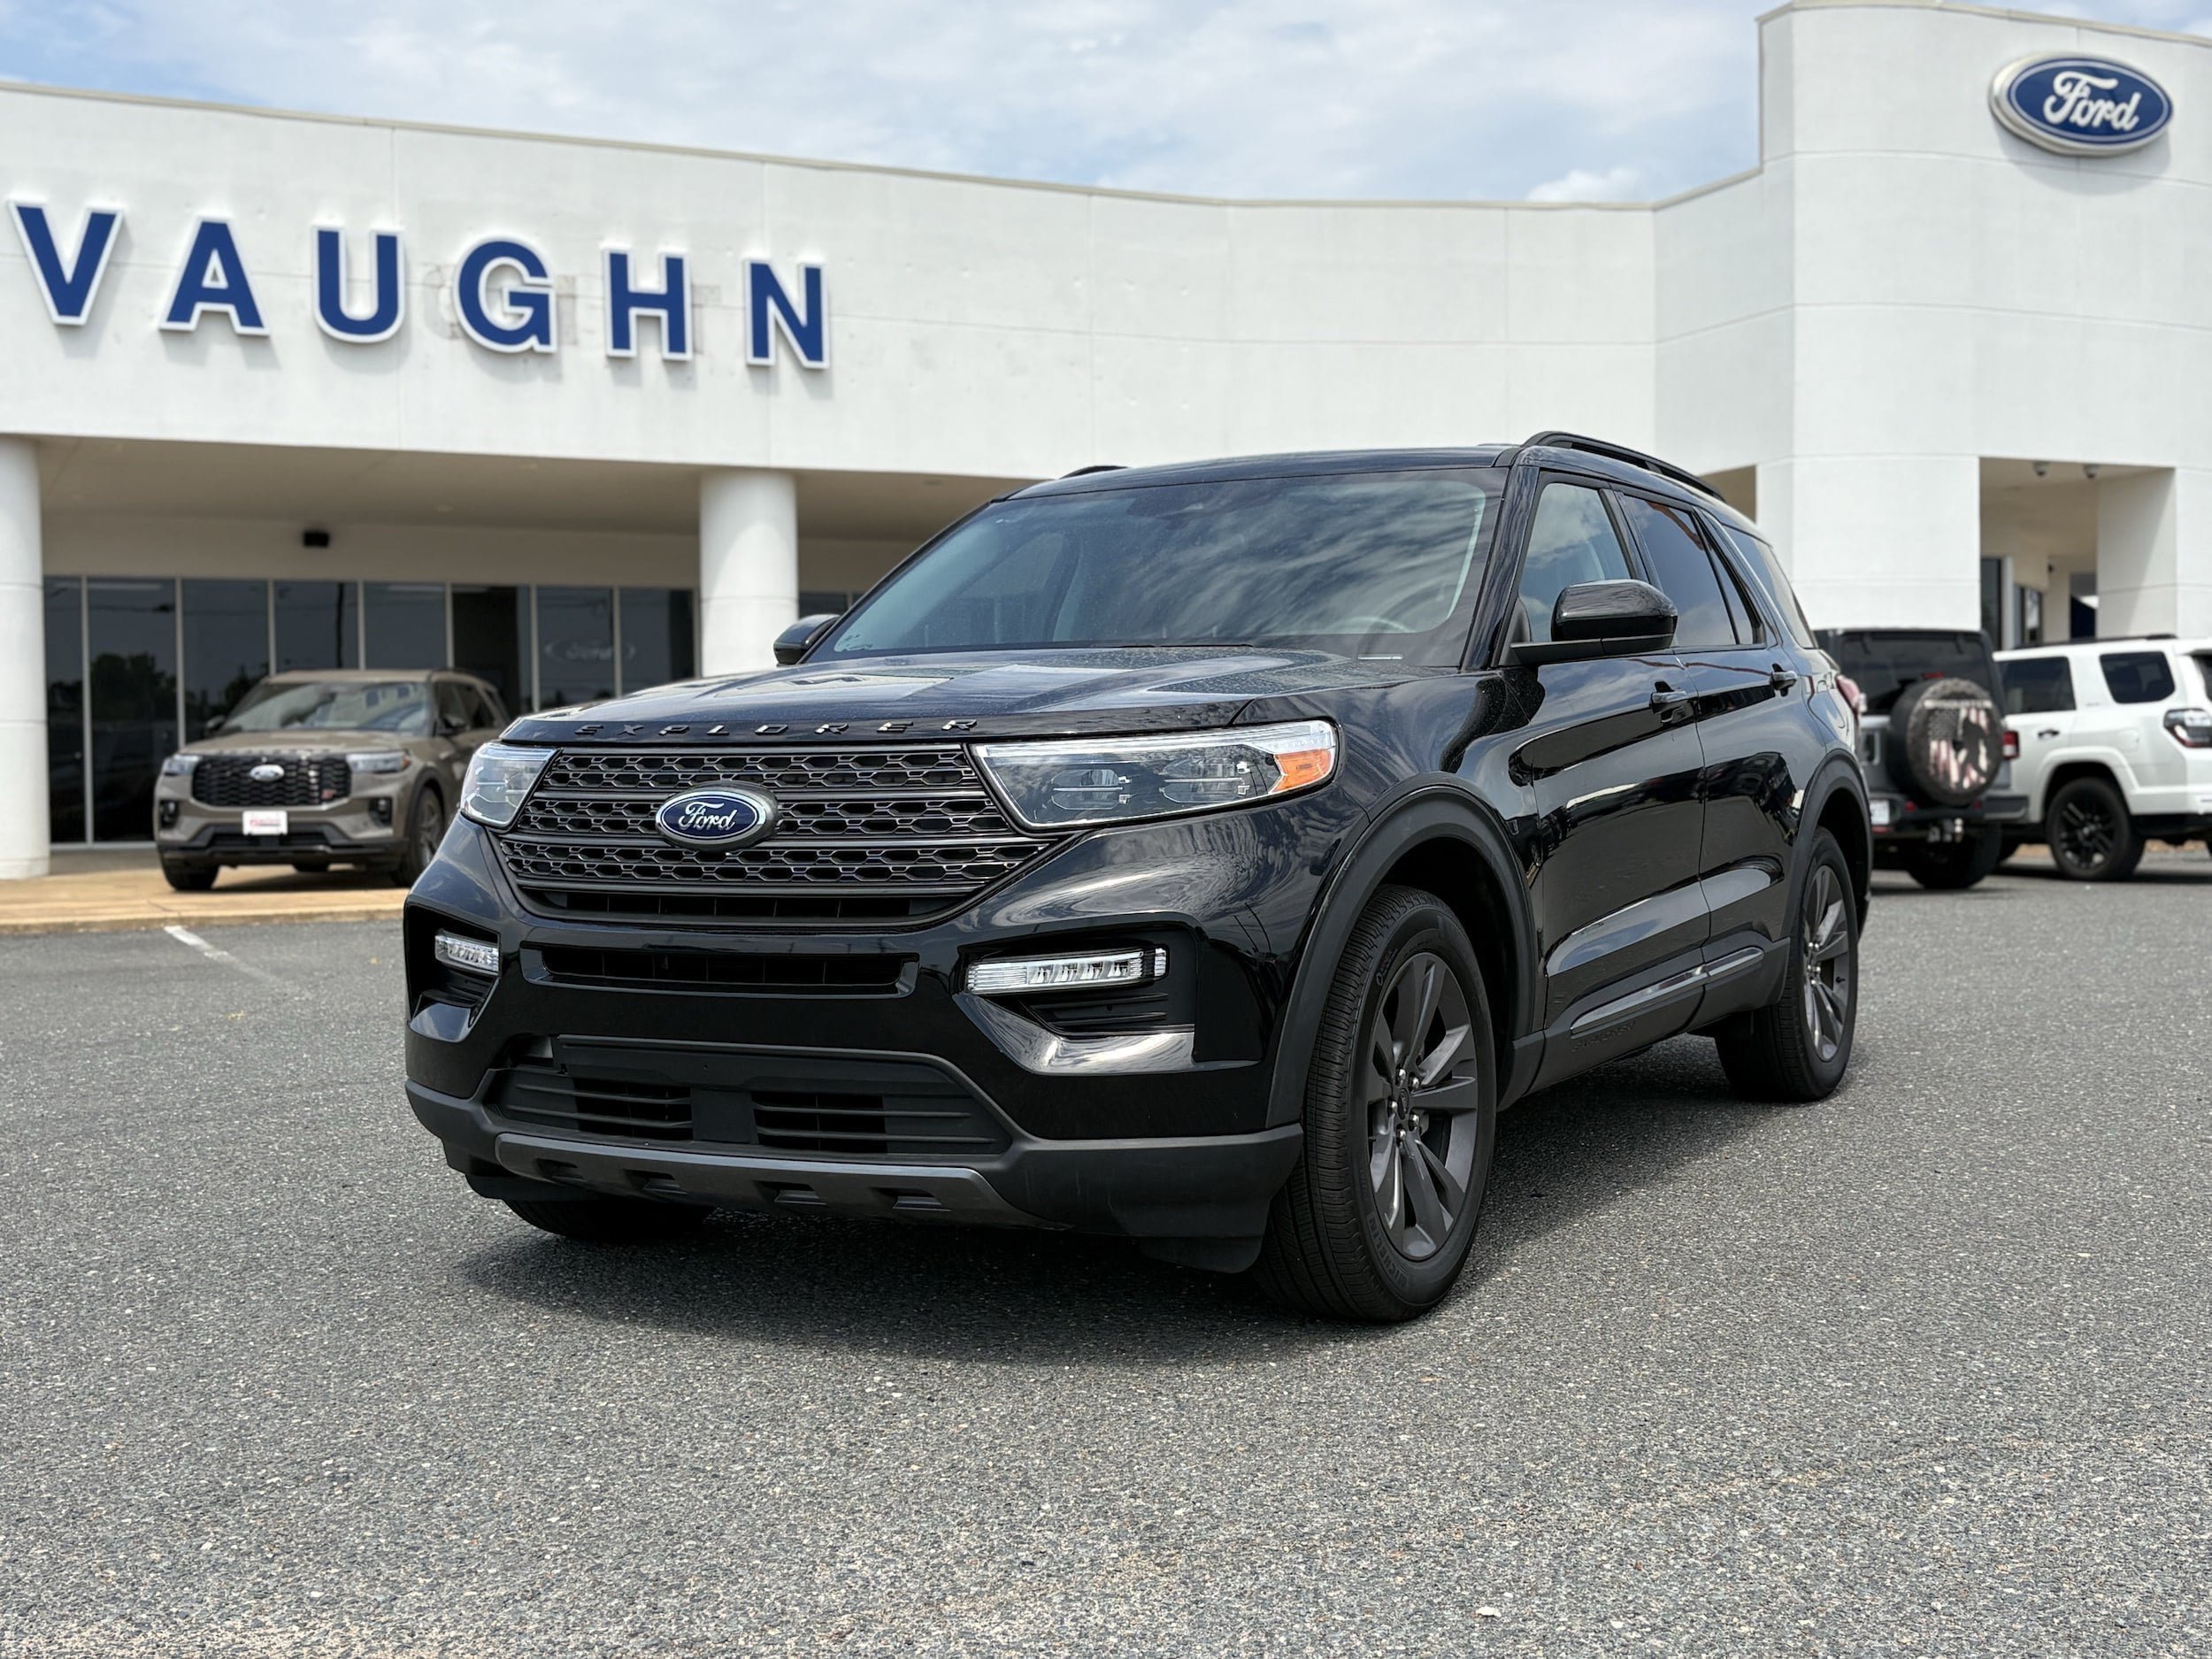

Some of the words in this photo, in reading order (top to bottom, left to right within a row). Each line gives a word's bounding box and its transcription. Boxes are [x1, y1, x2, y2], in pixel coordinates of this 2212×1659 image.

[2043, 70, 2142, 131] Ford
[7, 200, 830, 371] VAUGHN
[573, 718, 979, 737] EXPLORER
[678, 801, 738, 831] Ford
[1365, 1210, 1409, 1289] MICHELIN
